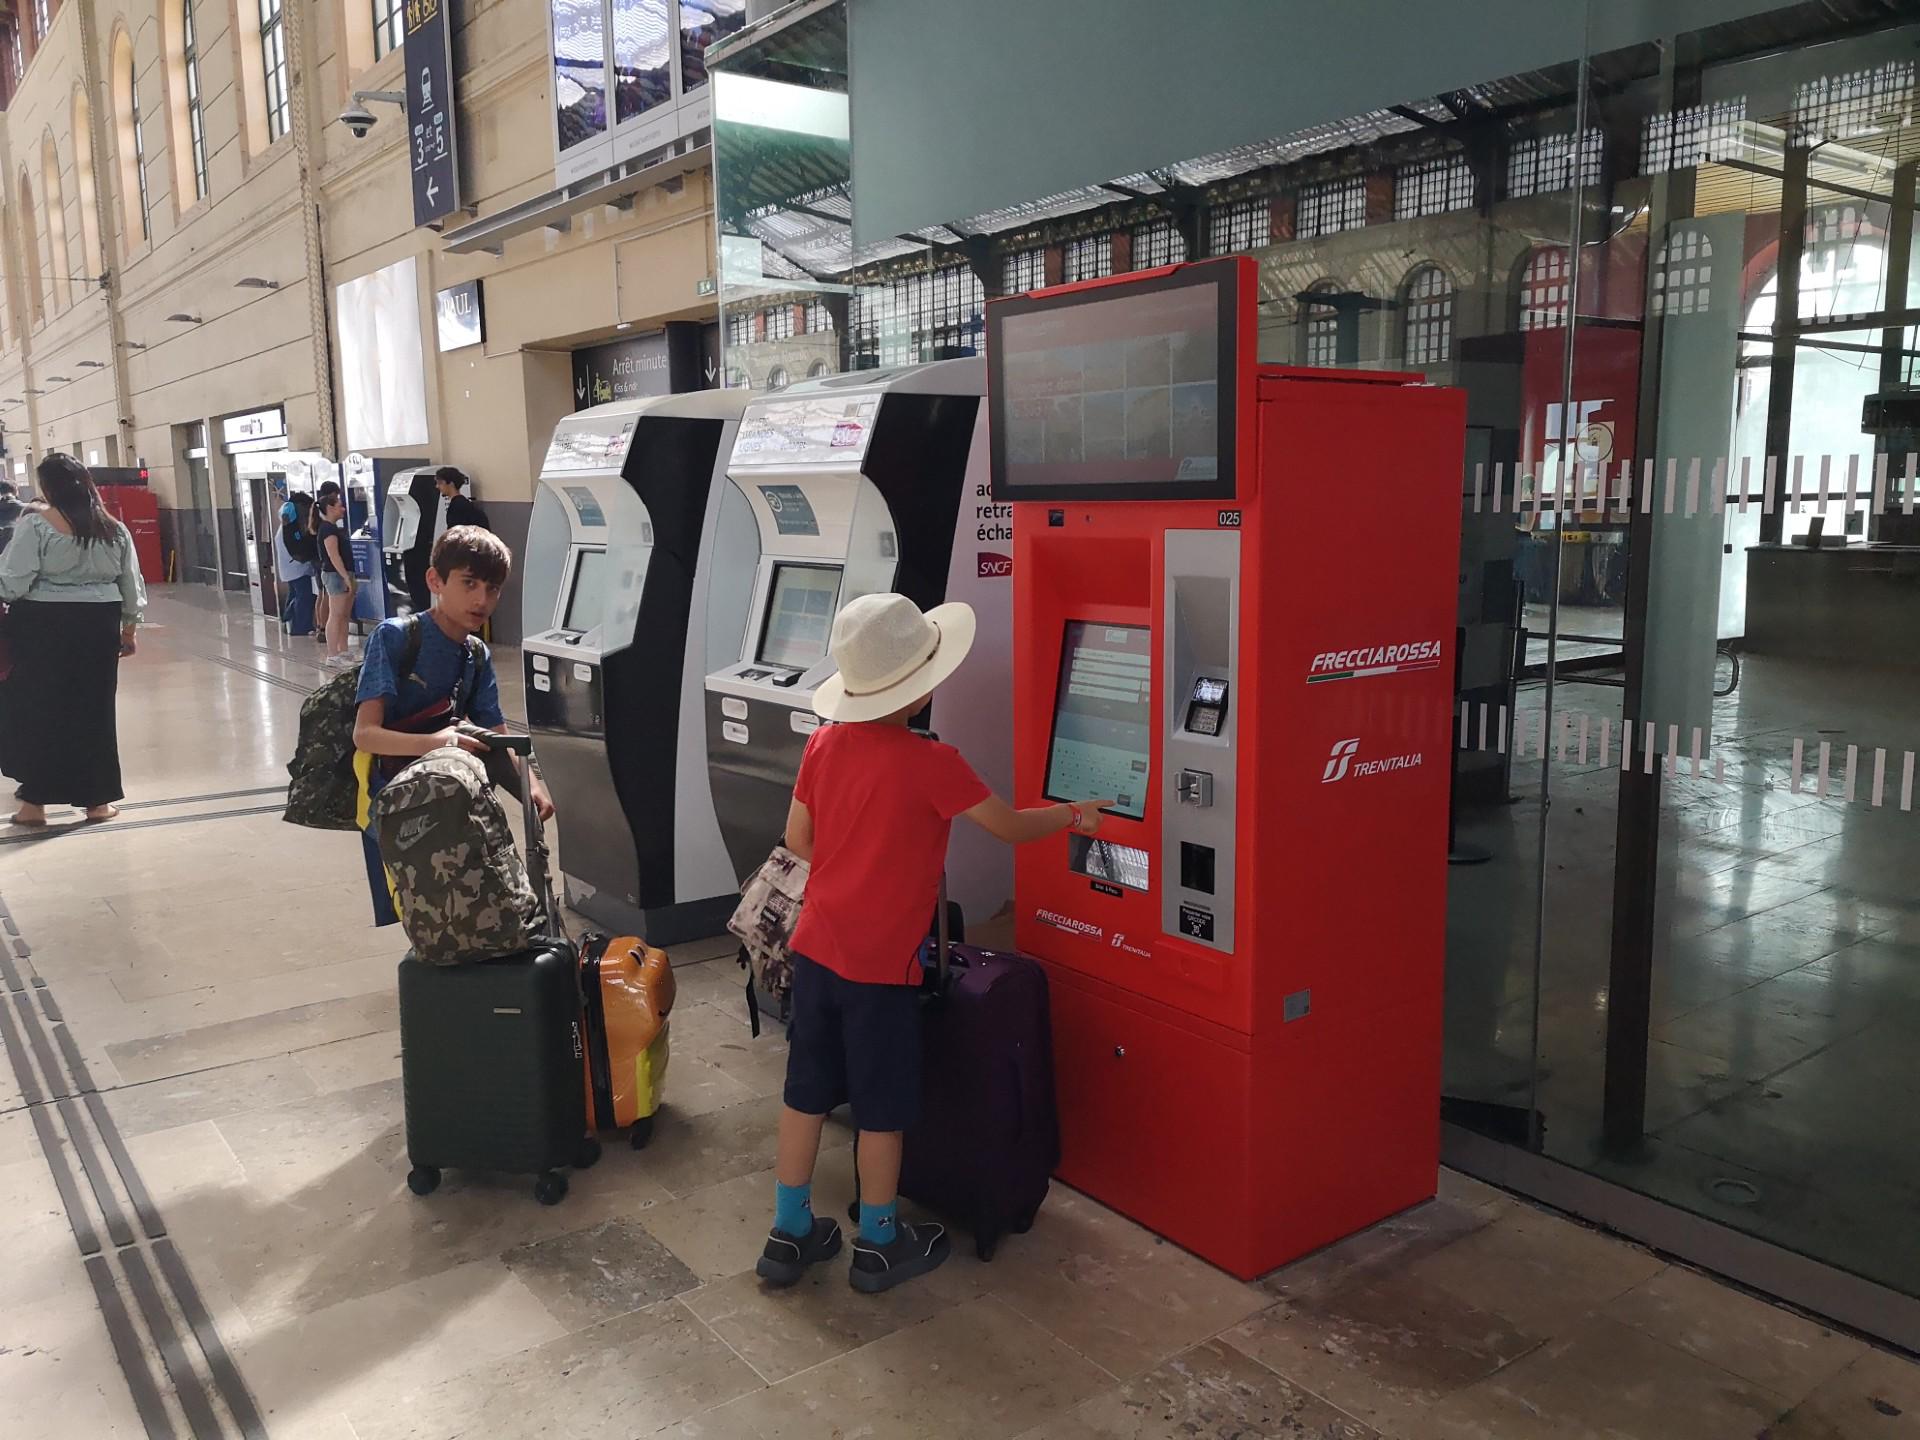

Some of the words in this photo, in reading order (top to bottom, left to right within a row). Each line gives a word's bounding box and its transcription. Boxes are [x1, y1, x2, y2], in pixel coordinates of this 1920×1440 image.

[416, 137, 425, 164] 3
[435, 125, 444, 154] 5
[443, 292, 472, 317] PAUL
[612, 356, 635, 376] Arrêt
[635, 353, 667, 372] minute
[1219, 512, 1240, 525] 025
[976, 523, 1012, 541] écha
[980, 560, 1011, 575] SNCF
[1310, 640, 1441, 673] FRECCIAROSSA
[1353, 753, 1423, 777] TRENITALIA
[1036, 908, 1103, 937] FRECCIAROSSA
